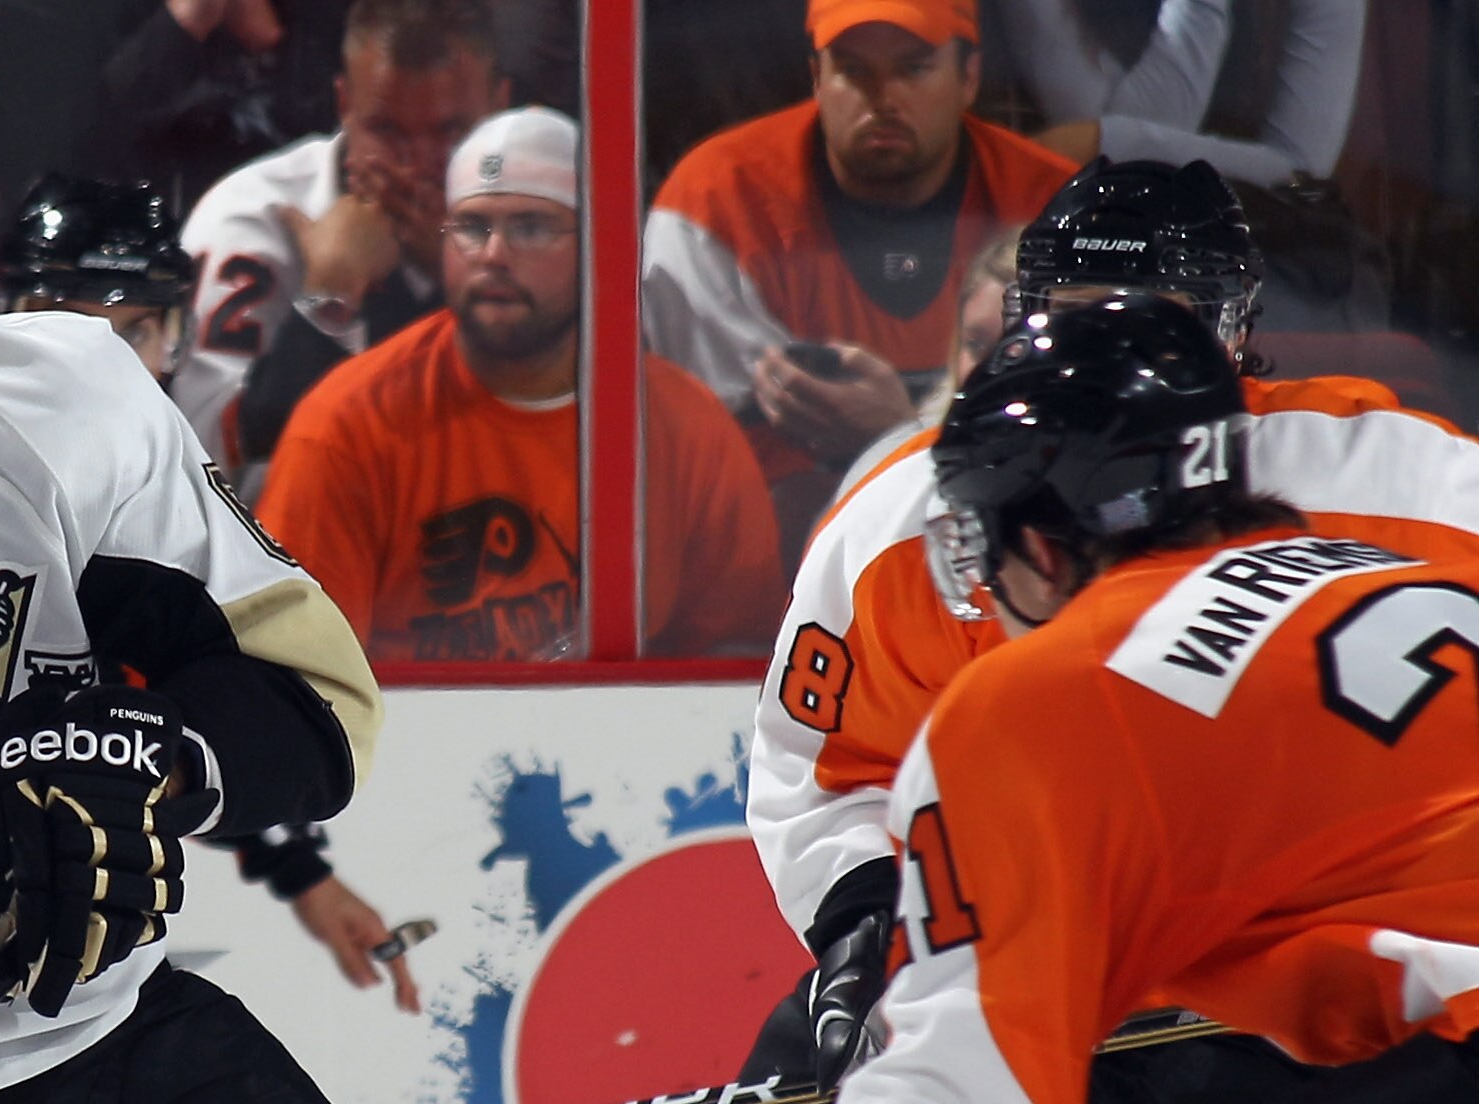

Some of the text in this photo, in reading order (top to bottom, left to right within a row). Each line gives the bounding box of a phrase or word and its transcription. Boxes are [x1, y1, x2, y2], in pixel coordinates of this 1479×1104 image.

[1072, 238, 1147, 253] BAUER
[1181, 421, 1229, 488] 21
[1162, 597, 1269, 678] VAN
[779, 621, 854, 733] 8
[110, 708, 164, 726] PENGUINS
